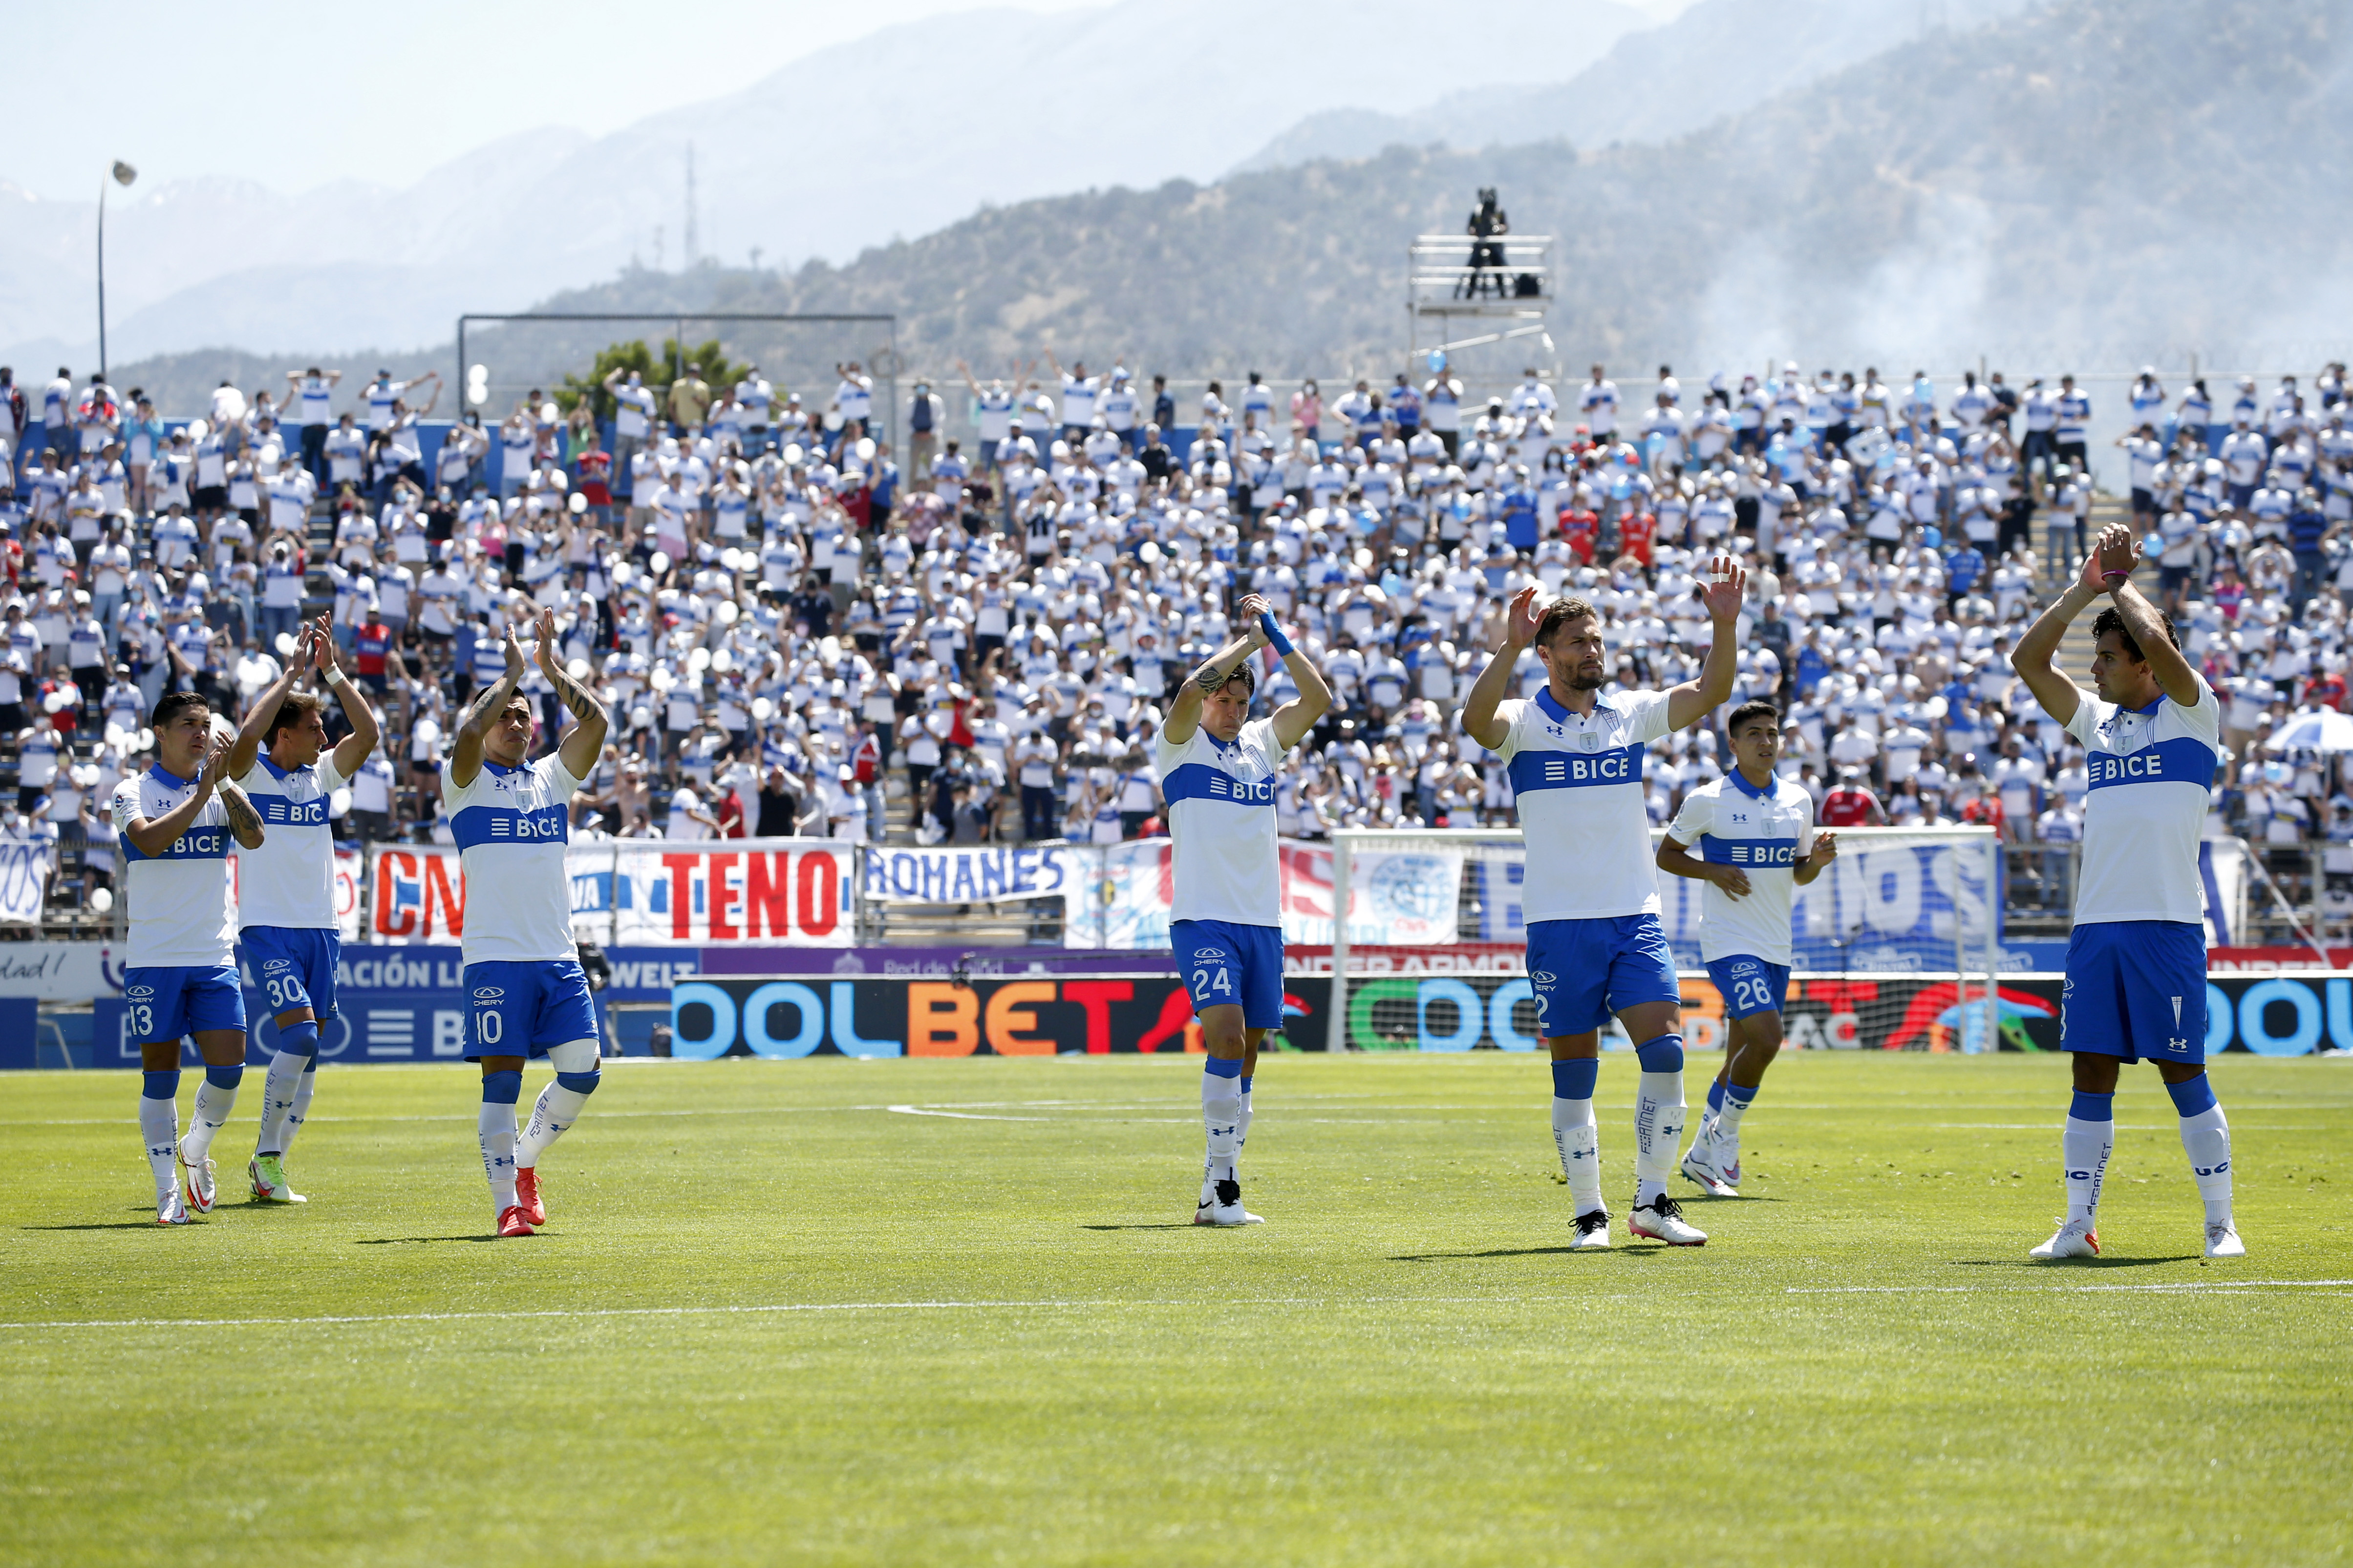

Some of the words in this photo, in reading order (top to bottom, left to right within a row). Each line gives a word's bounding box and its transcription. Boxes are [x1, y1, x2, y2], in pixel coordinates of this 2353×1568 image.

[1572, 758, 1629, 780] BICE
[2105, 755, 2162, 780] BICE
[290, 805, 323, 822] BIC
[516, 817, 559, 837] BICE
[174, 835, 220, 853] BICE
[1754, 847, 1797, 863] BICE
[865, 849, 1064, 900] ROMANES
[663, 851, 837, 939] TENO
[265, 968, 291, 978] CHERY
[609, 961, 696, 989] WELT
[1284, 956, 1394, 971] NDER
[1400, 955, 1526, 971] ARMO
[1732, 971, 1759, 980] CHERY
[266, 975, 303, 1008] 30
[1192, 967, 1232, 1002] 24
[1735, 977, 1771, 1011] 26
[129, 1004, 153, 1036] 13
[476, 1010, 502, 1044] 10
